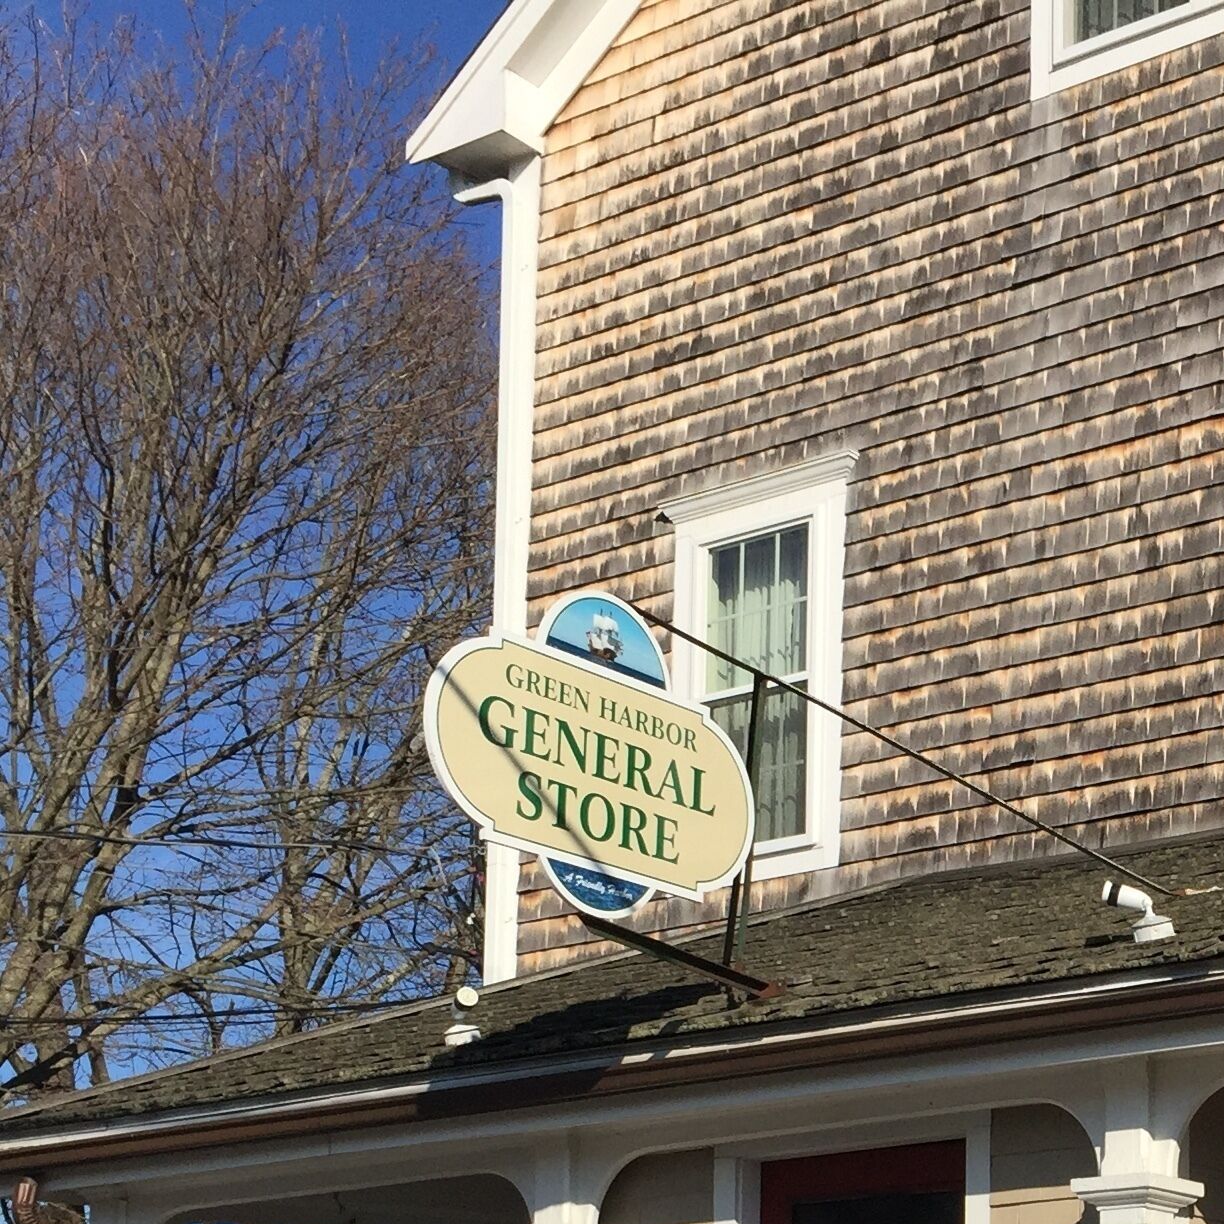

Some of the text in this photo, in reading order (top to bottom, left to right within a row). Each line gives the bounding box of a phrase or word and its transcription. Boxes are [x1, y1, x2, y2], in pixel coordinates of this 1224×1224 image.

[478, 694, 717, 817] GENERAL
[505, 662, 699, 753] GREEN HARBOR
[516, 770, 681, 866] STORE
